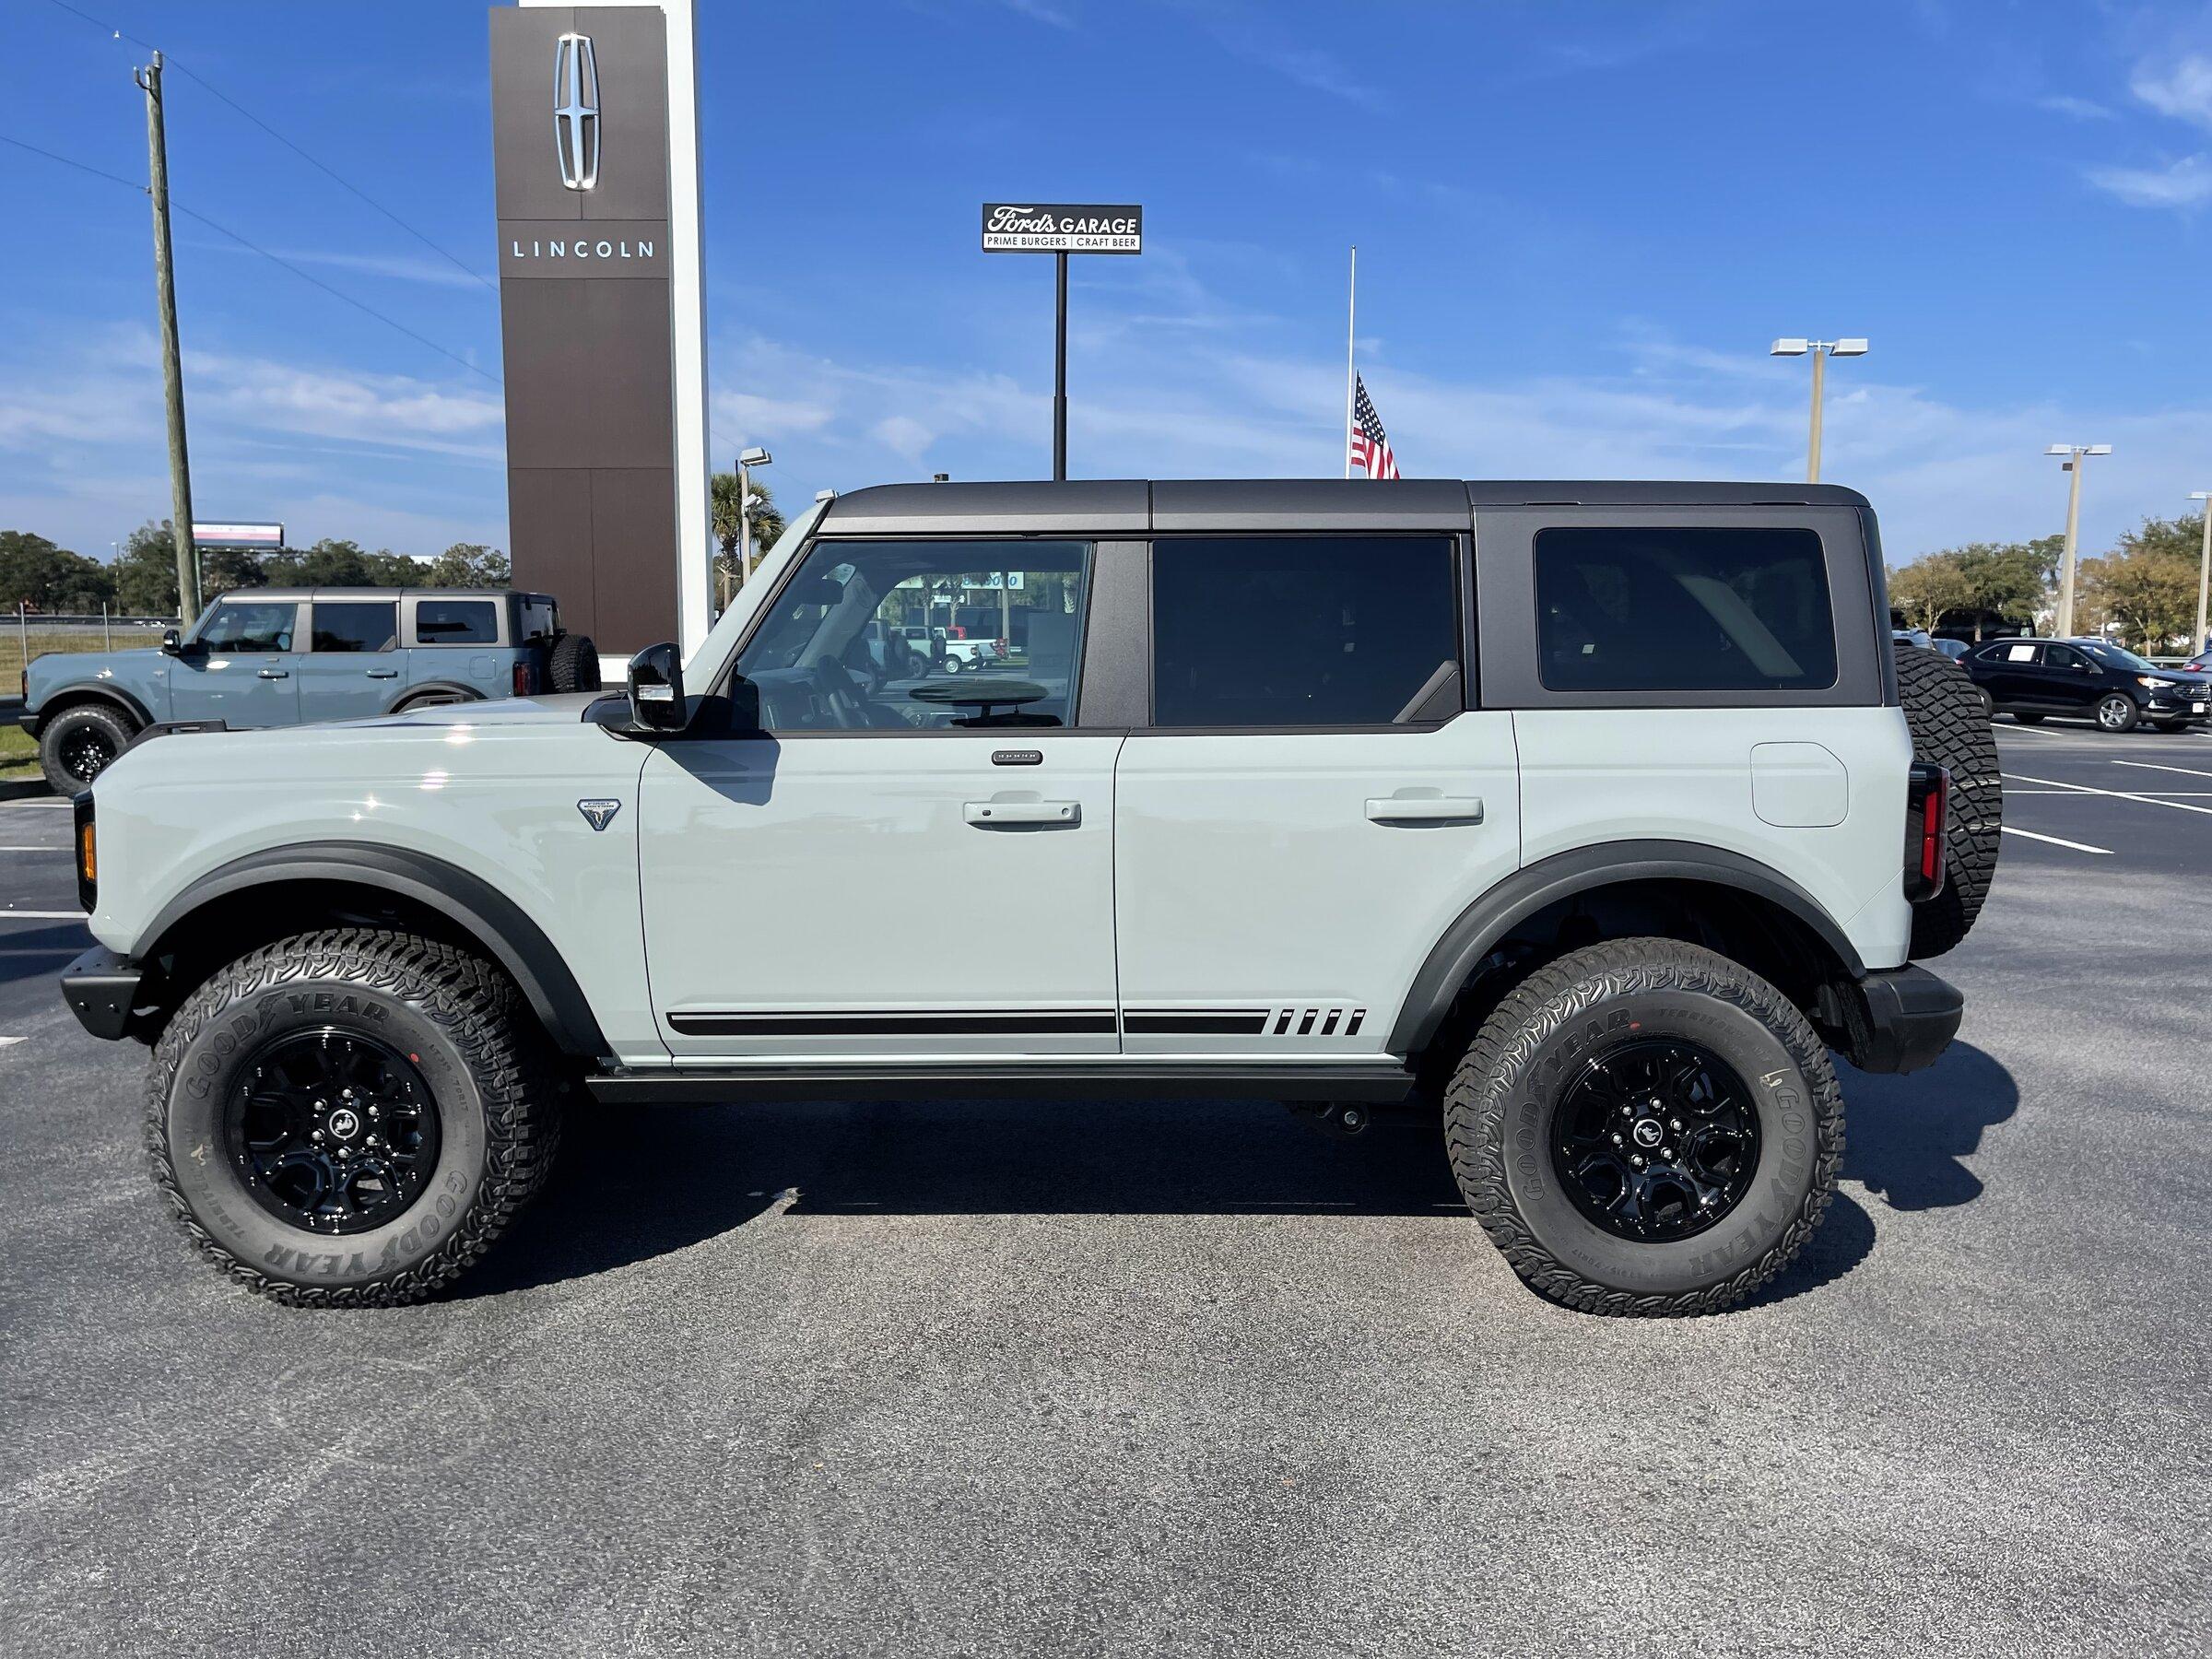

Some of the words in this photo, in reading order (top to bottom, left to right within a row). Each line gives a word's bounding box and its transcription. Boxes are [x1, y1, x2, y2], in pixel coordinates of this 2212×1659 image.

[987, 206, 1057, 233] Ford's
[1060, 218, 1136, 234] GARAGE
[513, 241, 653, 258] LINCOLN
[987, 236, 1018, 246] PRIME
[1021, 237, 1066, 246] BURGERS
[1077, 237, 1109, 247] CRAFT
[1112, 238, 1136, 247] BEER
